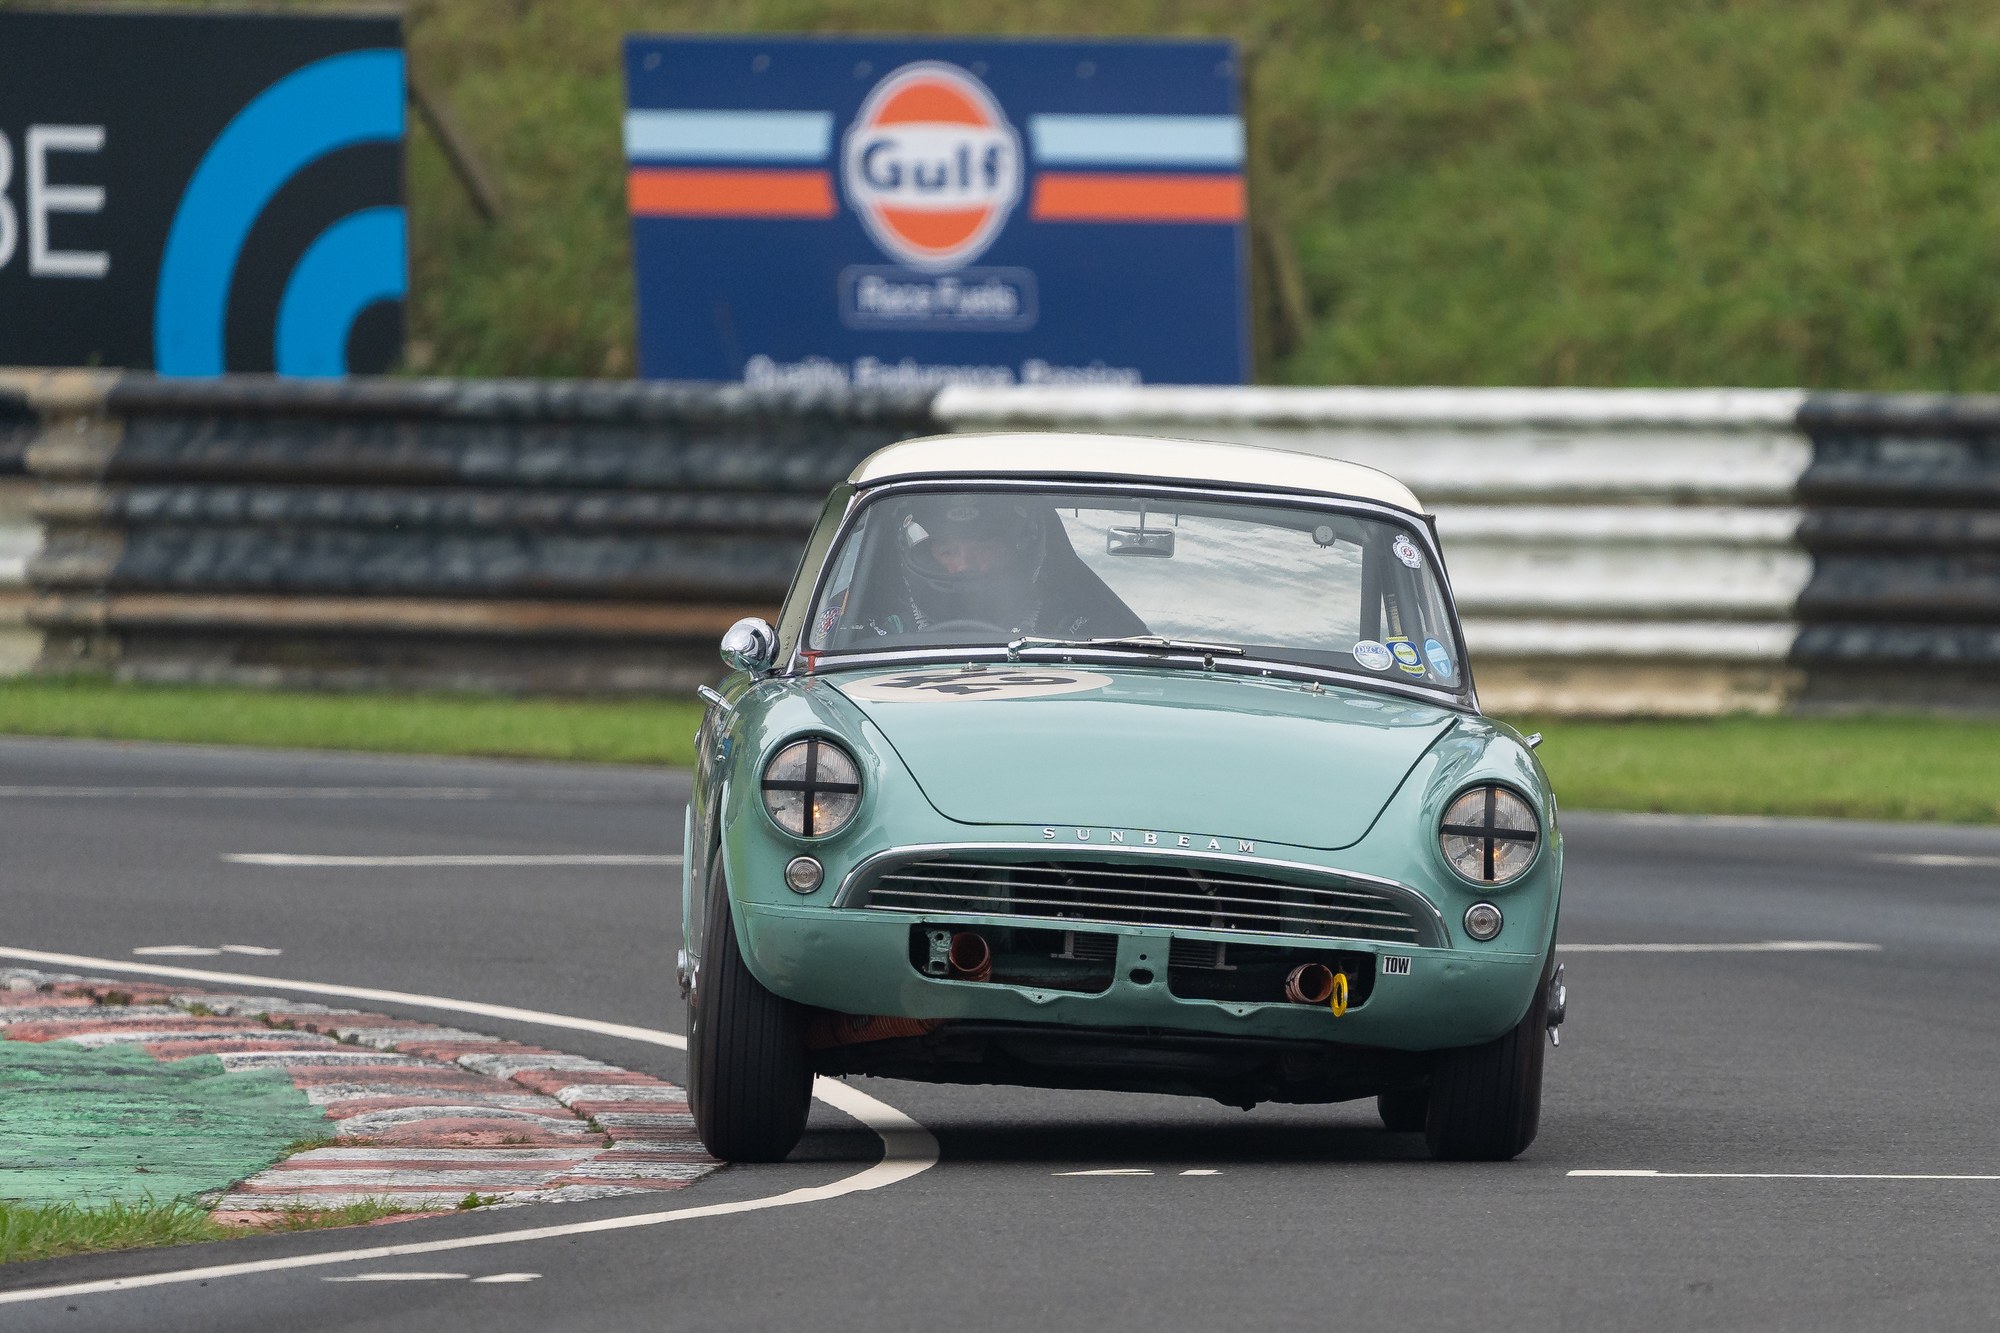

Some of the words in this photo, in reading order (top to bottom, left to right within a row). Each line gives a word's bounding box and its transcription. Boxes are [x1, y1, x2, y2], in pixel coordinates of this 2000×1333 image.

[861, 137, 1003, 193] Gulf
[0, 123, 110, 278] E
[1042, 827, 1255, 853] SUNBEAM
[1384, 956, 1410, 974] TOW
